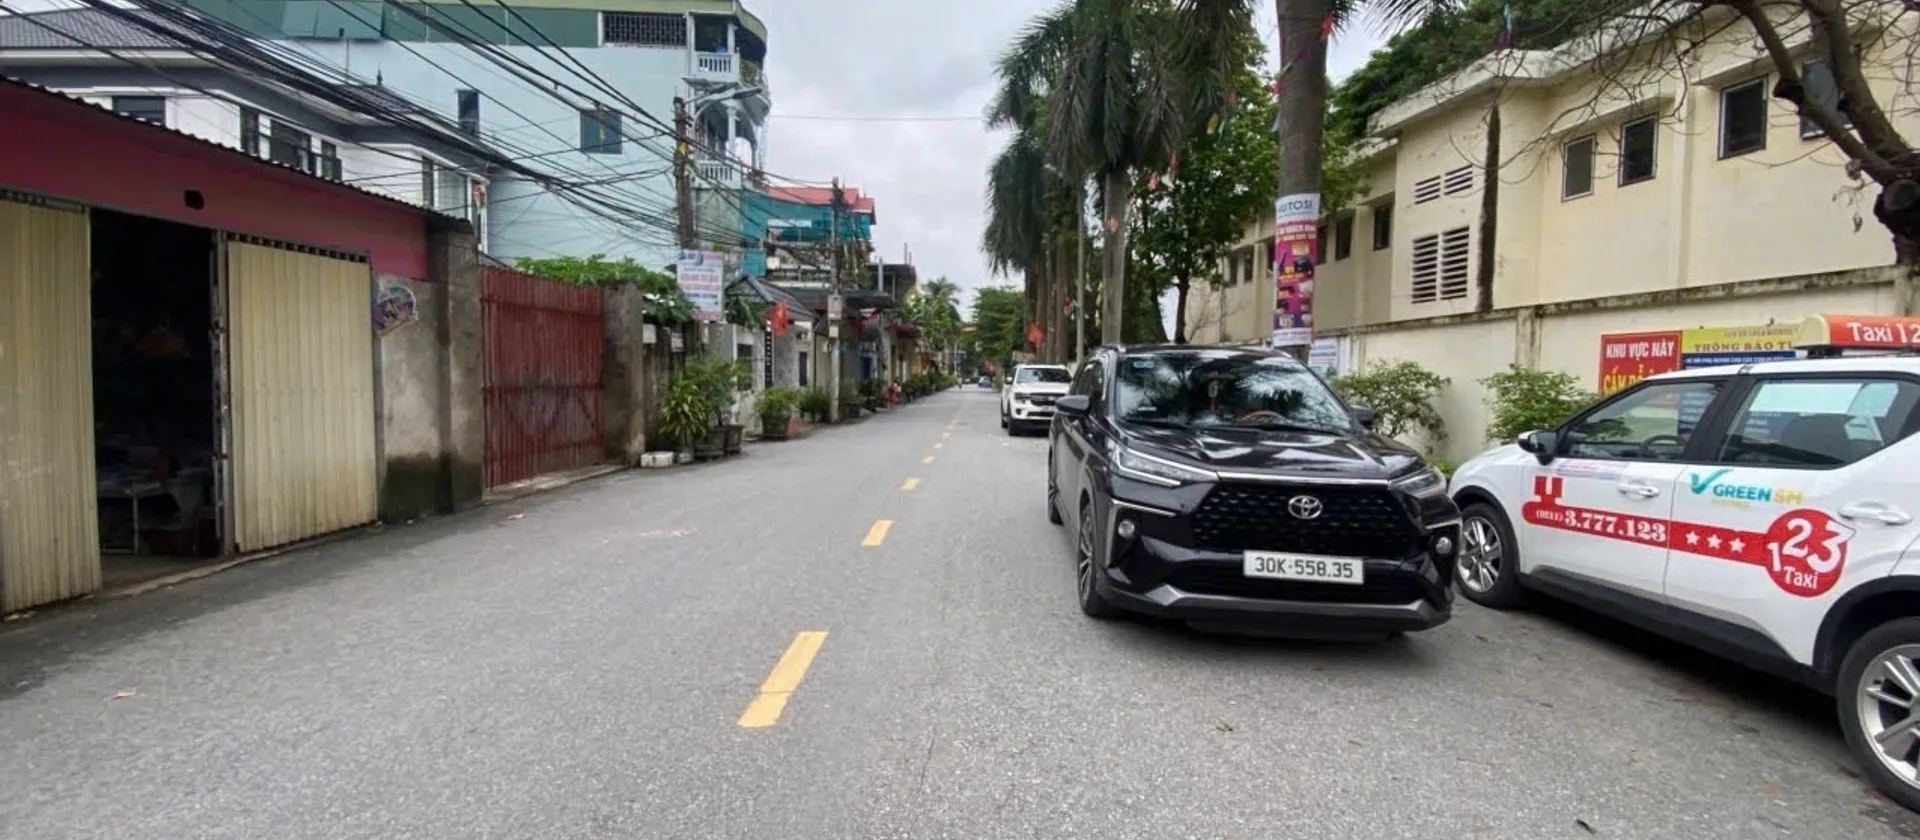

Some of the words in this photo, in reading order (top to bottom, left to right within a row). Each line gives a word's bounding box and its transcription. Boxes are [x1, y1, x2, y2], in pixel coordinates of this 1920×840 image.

[1846, 321, 1893, 342] Taxi
[1605, 343, 1627, 359] KHU
[1628, 341, 1650, 361] VỰC
[1651, 338, 1675, 357] NÀY
[1693, 341, 1740, 352] THÔNG
[1712, 484, 1773, 502] GREEN
[1774, 487, 1804, 505] SM
[1564, 509, 1668, 542] 3.777.123
[1766, 517, 1854, 573] 123
[1783, 565, 1819, 590] Taxi
